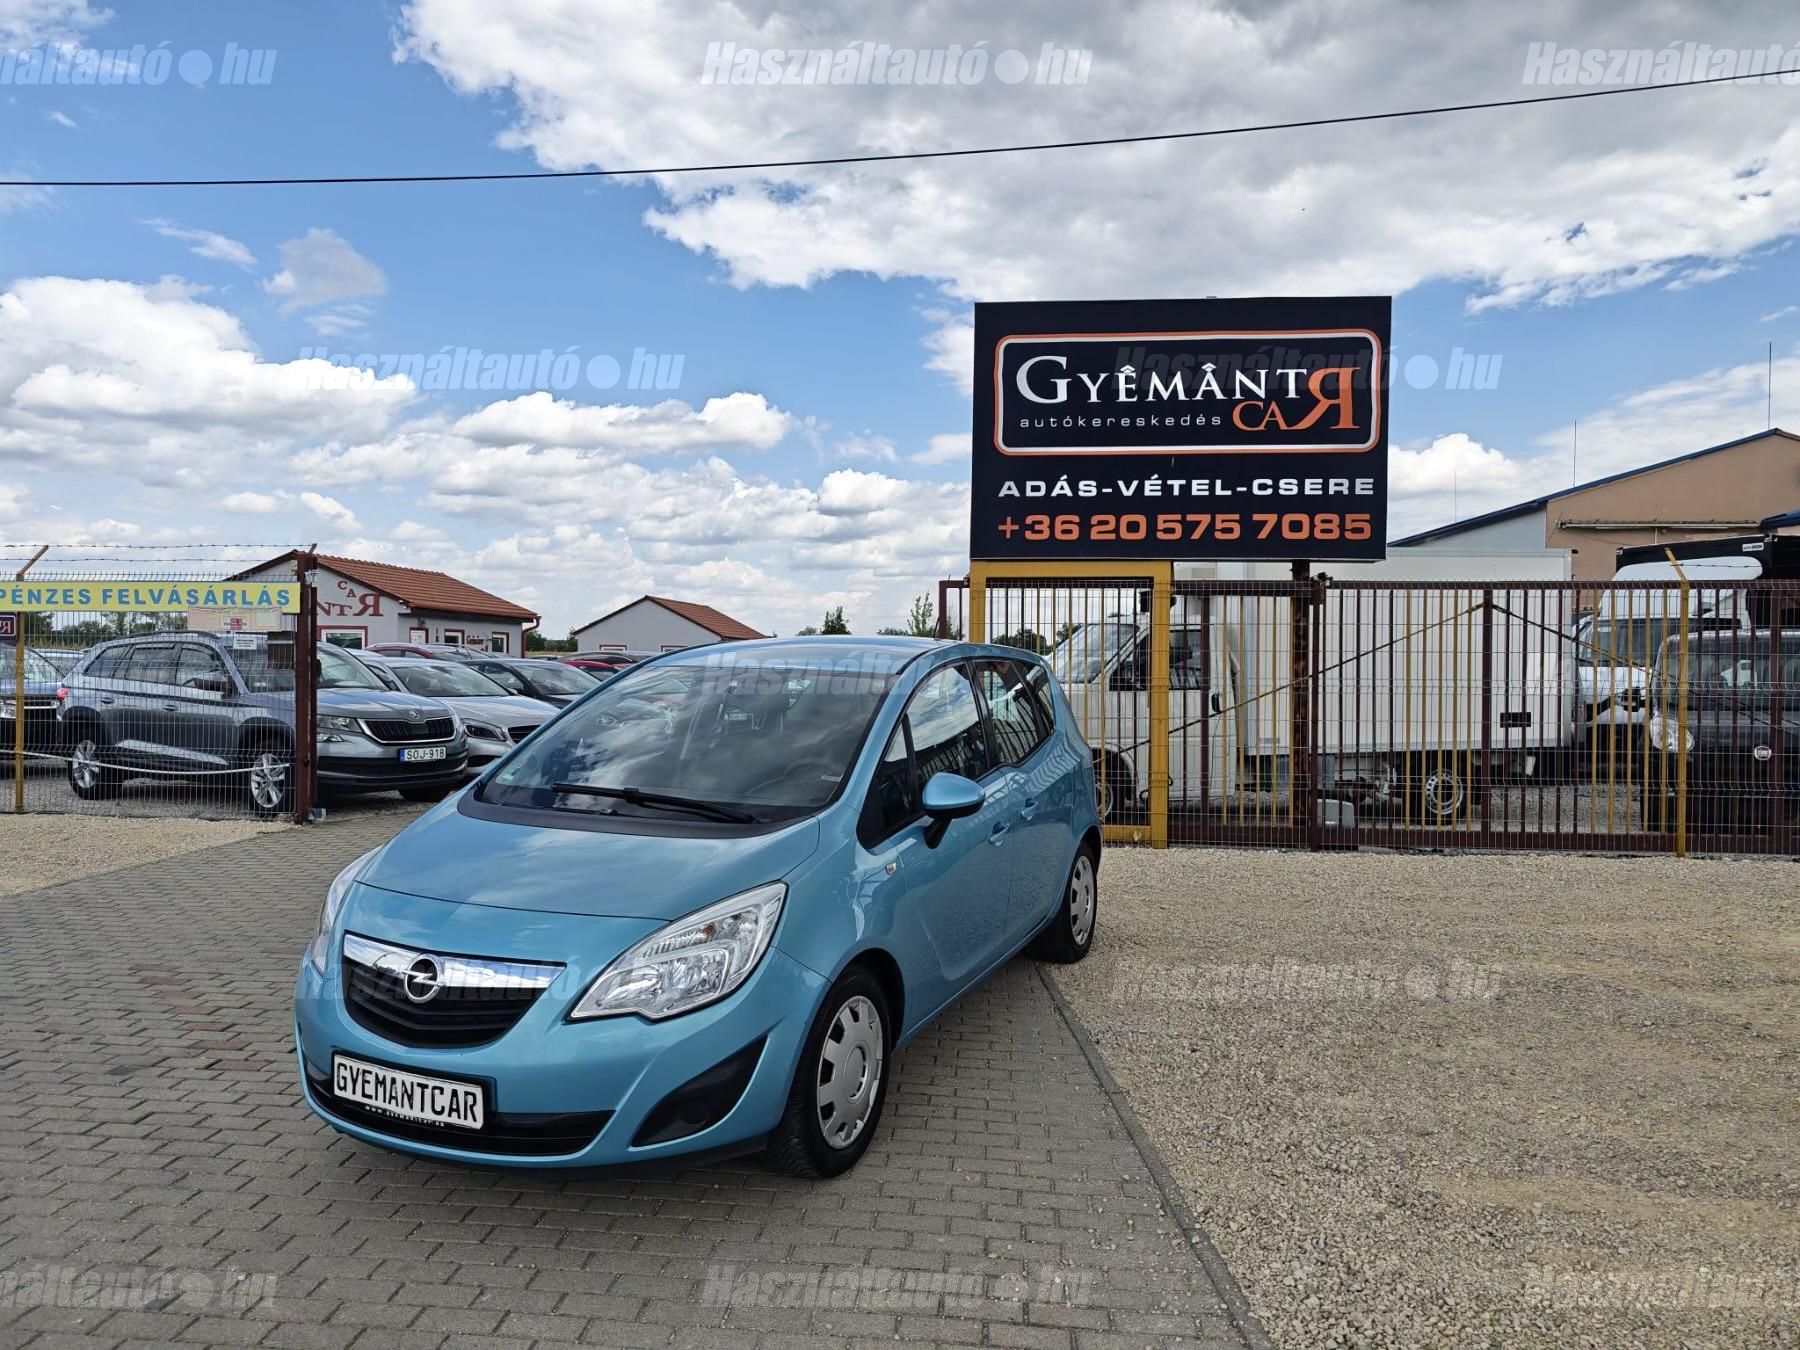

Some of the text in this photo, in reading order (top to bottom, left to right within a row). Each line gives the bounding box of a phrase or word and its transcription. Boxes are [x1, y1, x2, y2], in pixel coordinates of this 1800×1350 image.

[1020, 413, 1222, 428] autókereskedés
[998, 474, 1375, 498] ADÁS-VÉTEL-CSERE
[998, 513, 1372, 541] +36 20 575 7085
[102, 585, 290, 606] FELVÁSÁRLÁS
[337, 1062, 478, 1123] GYEMANTCAR
